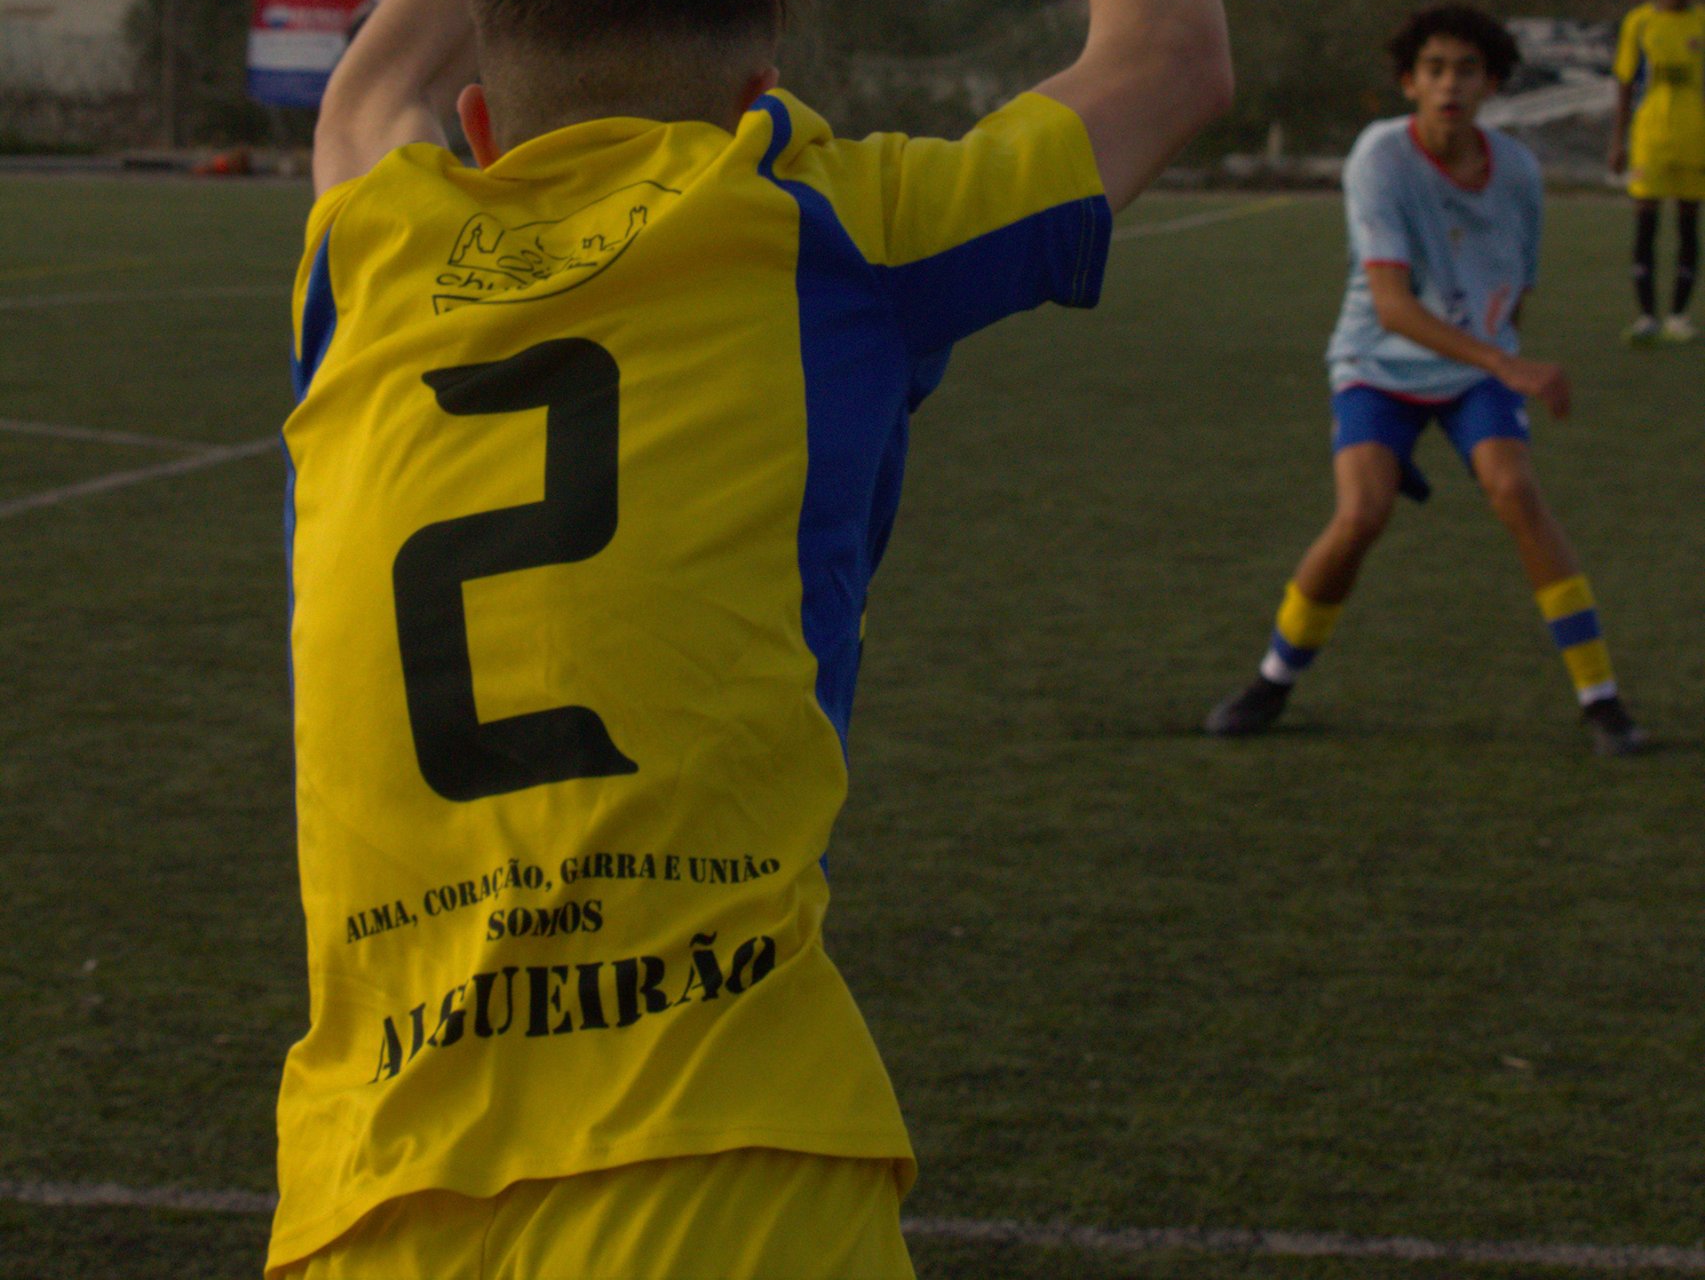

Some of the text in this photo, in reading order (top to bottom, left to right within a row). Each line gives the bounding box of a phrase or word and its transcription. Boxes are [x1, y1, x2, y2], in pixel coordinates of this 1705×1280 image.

[392, 337, 640, 803] 2
[347, 900, 418, 944] ALMA,
[423, 858, 553, 917] CORAÇÃO,
[664, 855, 681, 880] E
[689, 854, 781, 884] UNIÃO
[486, 899, 604, 942] SOMOS
